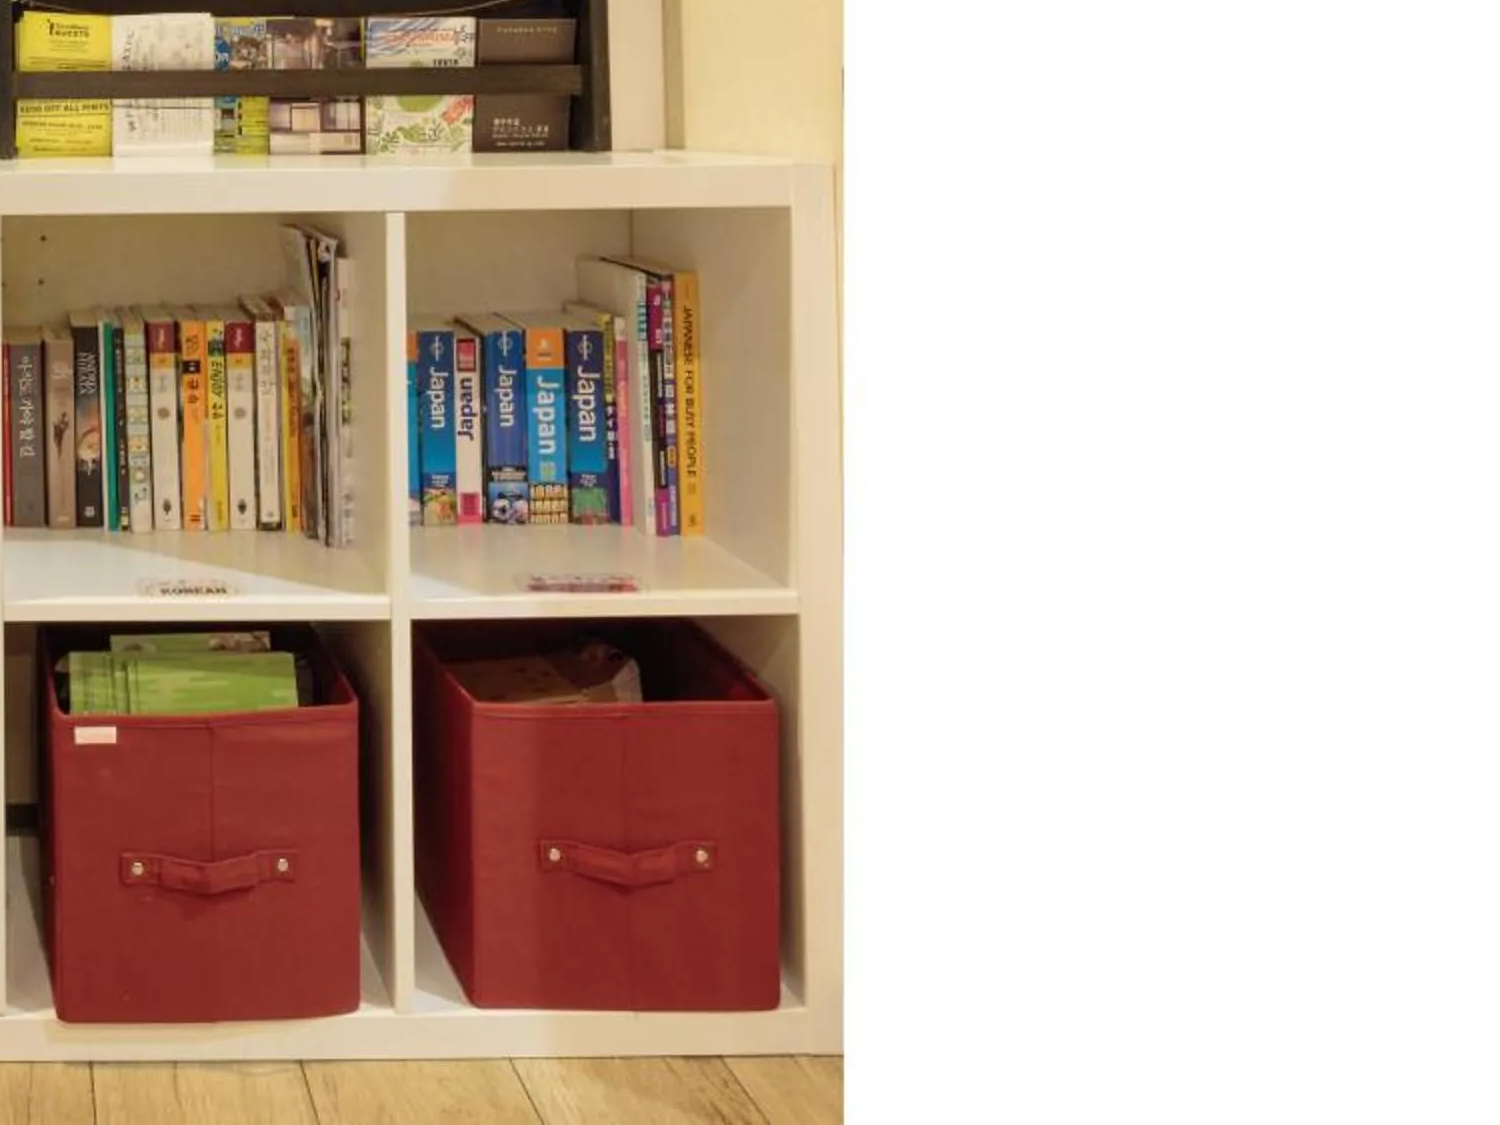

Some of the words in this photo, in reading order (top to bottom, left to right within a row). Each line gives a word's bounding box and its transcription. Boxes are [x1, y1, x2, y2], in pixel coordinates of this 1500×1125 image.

[682, 305, 693, 365] JAPANESE
[430, 368, 448, 428] Japan
[457, 377, 478, 441] Japan
[498, 366, 517, 427] Japan
[572, 367, 600, 442] Japan
[683, 370, 694, 395] FOR
[533, 376, 560, 455] Japan
[686, 430, 697, 477] PEOPLE
